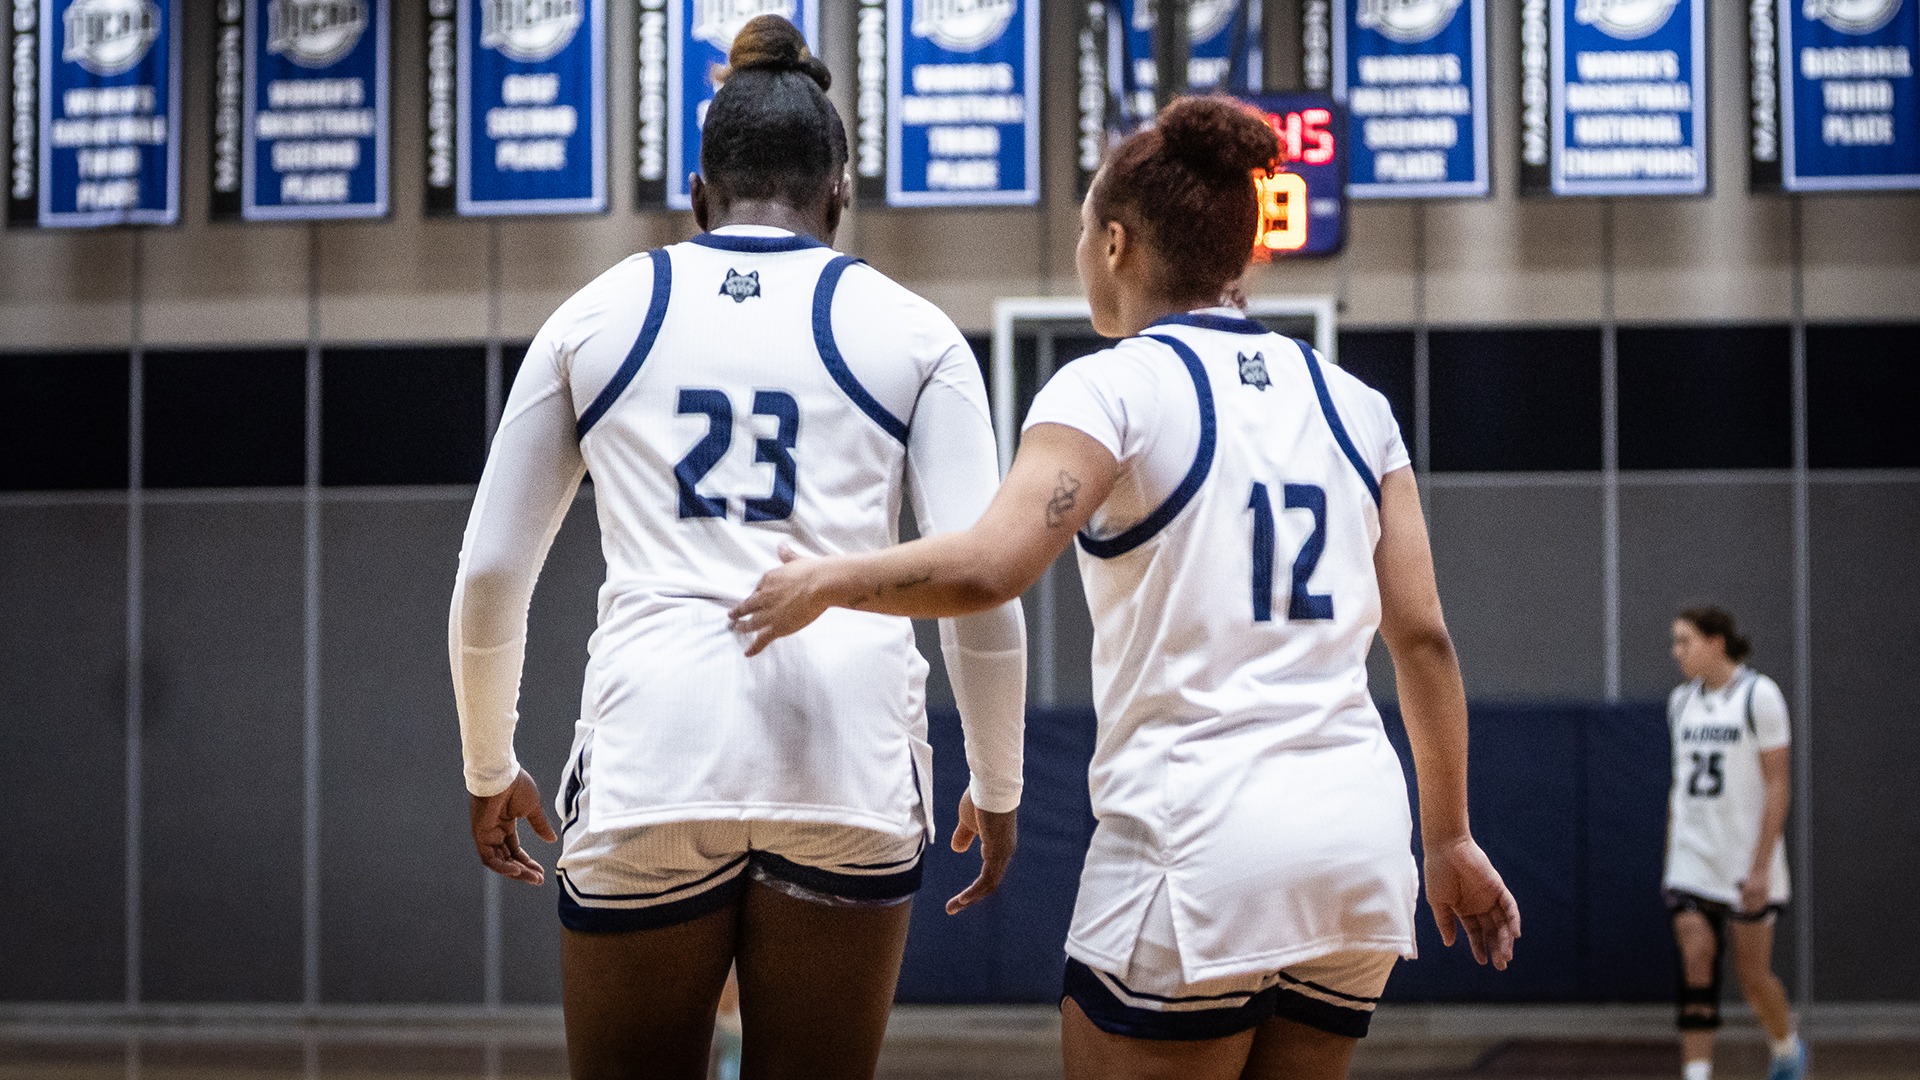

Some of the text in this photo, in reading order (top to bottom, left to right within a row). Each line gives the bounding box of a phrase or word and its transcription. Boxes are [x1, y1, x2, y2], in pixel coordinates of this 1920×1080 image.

[1358, 54, 1461, 83] WOMEN'S
[1577, 50, 1679, 80] WOMEN'S
[1801, 46, 1912, 79] BASEBALL
[1822, 80, 1894, 111] THIRD
[486, 106, 577, 138] SECOND
[1365, 119, 1457, 149] SECOND
[1574, 114, 1682, 145] NATIONAL
[1822, 114, 1894, 145] PLACE
[271, 141, 360, 172] SECOND
[496, 139, 567, 171] PLACE
[1374, 151, 1448, 181] PLACE
[1561, 148, 1697, 177] CHAMPIONS
[281, 173, 350, 201] PLACE
[926, 159, 998, 189] PLACE
[673, 387, 801, 523] 23
[1248, 482, 1334, 622] 12
[1687, 751, 1725, 798] 25
